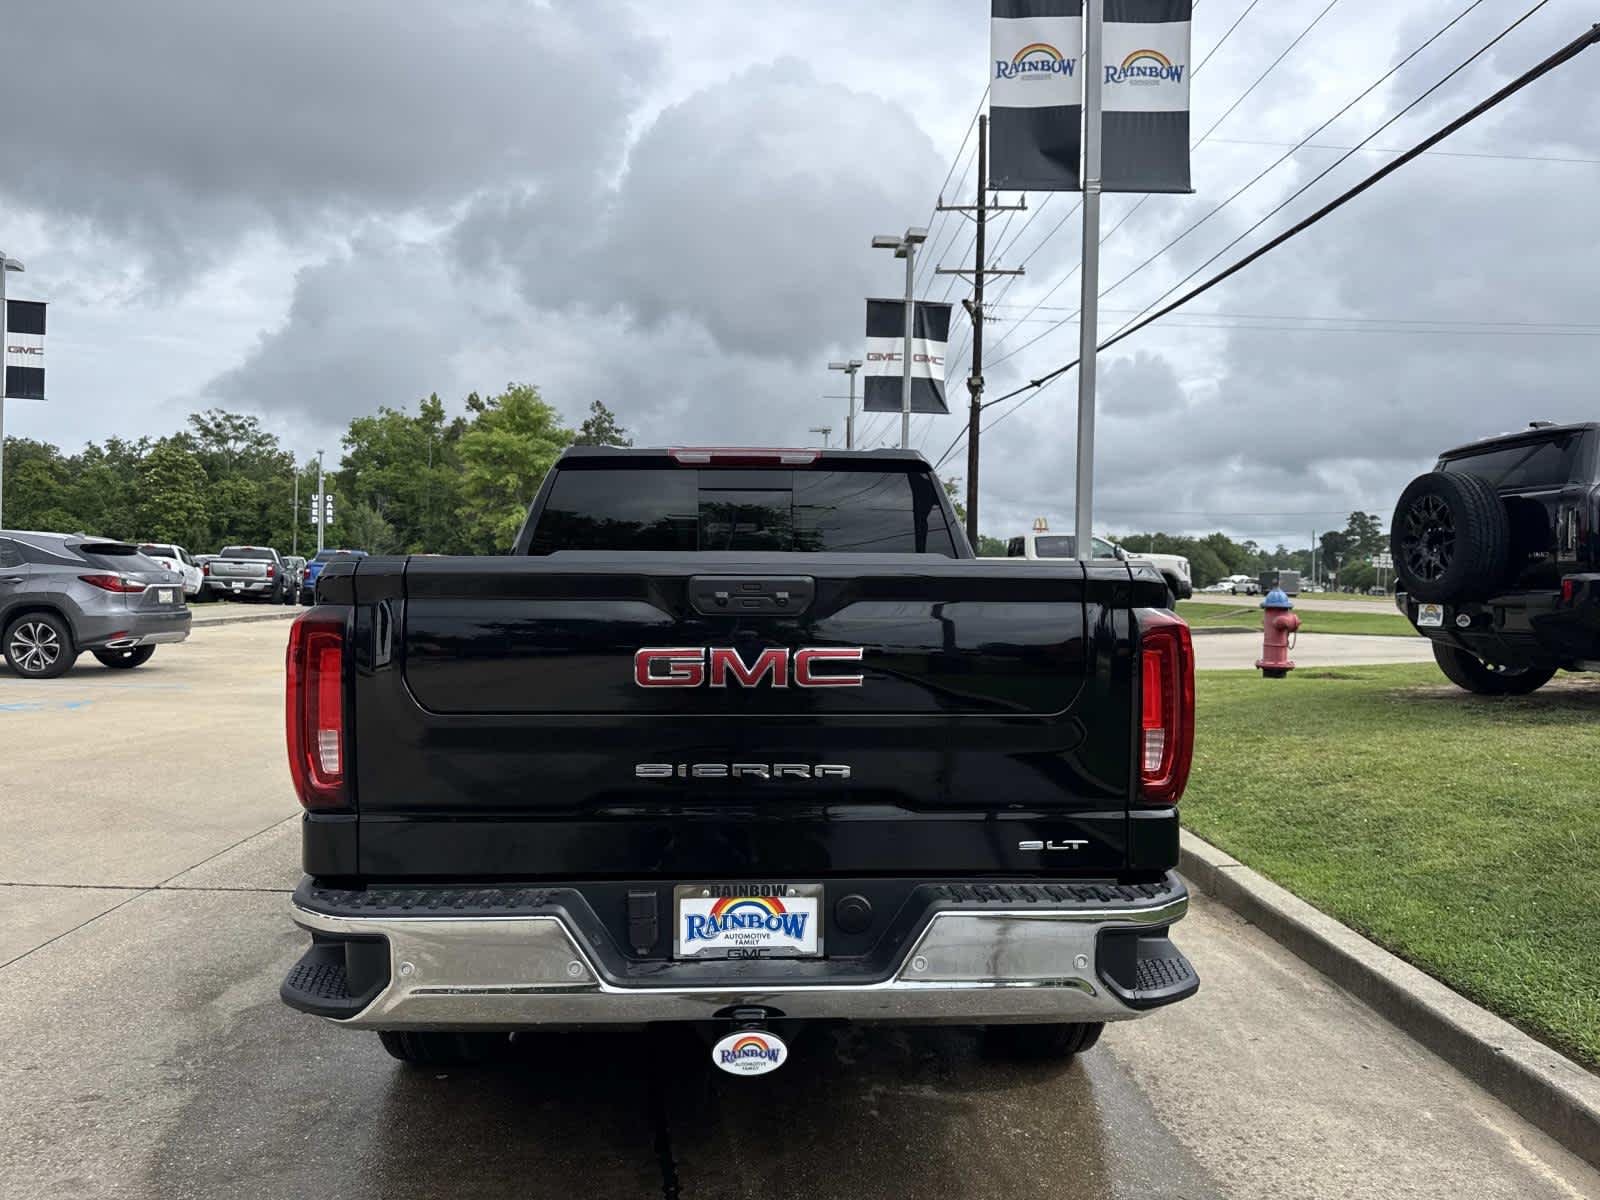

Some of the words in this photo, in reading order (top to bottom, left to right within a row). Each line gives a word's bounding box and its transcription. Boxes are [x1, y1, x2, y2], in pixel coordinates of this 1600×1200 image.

[995, 58, 1076, 79] RAINBOW
[1103, 64, 1185, 85] RAINBOW
[7, 345, 44, 355] GMC
[867, 353, 903, 361] GMC
[913, 354, 944, 366] GMC
[311, 494, 319, 524] USED
[326, 494, 334, 524] CARS
[634, 647, 864, 688] GMC
[635, 763, 851, 778] SIERRA
[1018, 840, 1089, 850] SLT
[710, 884, 788, 897] RAINBOW
[685, 912, 809, 942] RAINBOW
[724, 932, 771, 940] AUTOMOTIVE
[727, 948, 771, 960] GMC
[720, 1048, 780, 1064] RAINBOW
